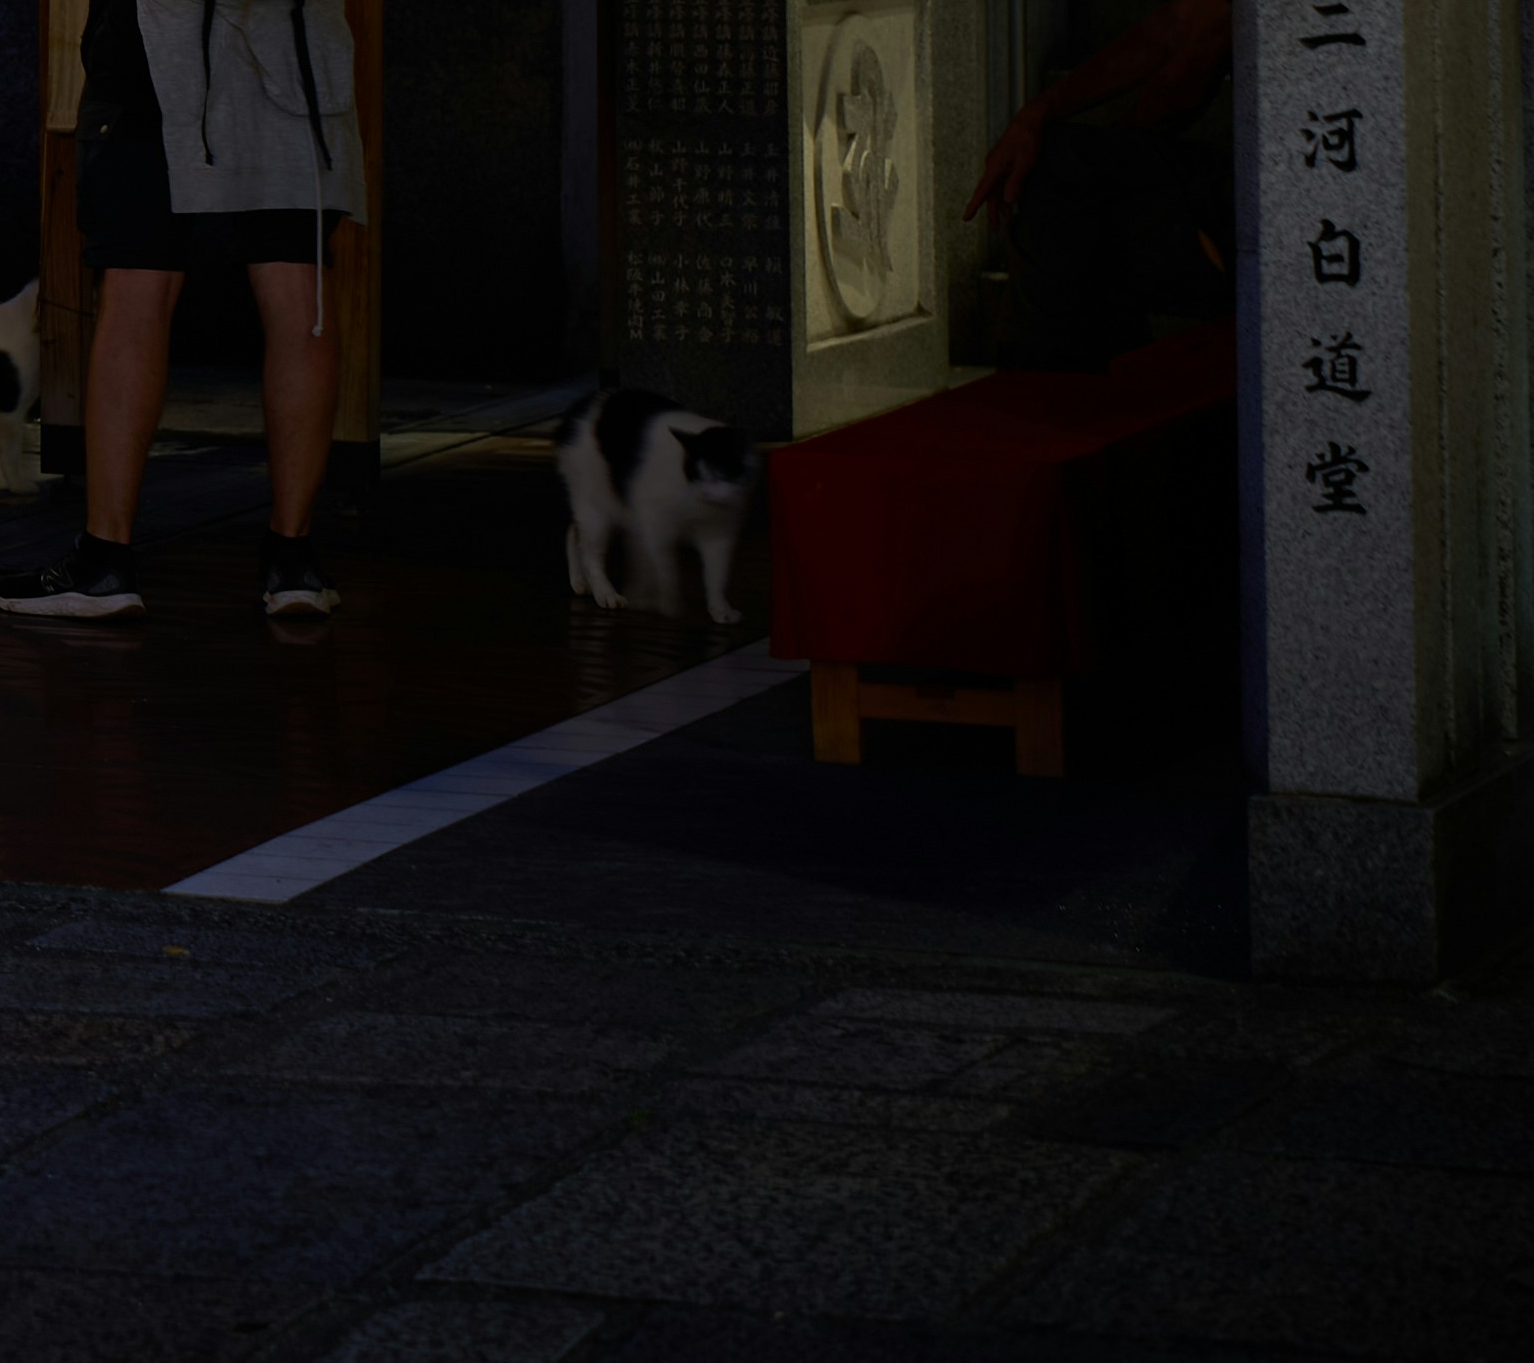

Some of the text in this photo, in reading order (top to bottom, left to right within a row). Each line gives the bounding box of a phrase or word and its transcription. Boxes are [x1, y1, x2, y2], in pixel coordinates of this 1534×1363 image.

[1299, 3, 1372, 516] 二河白道堂
